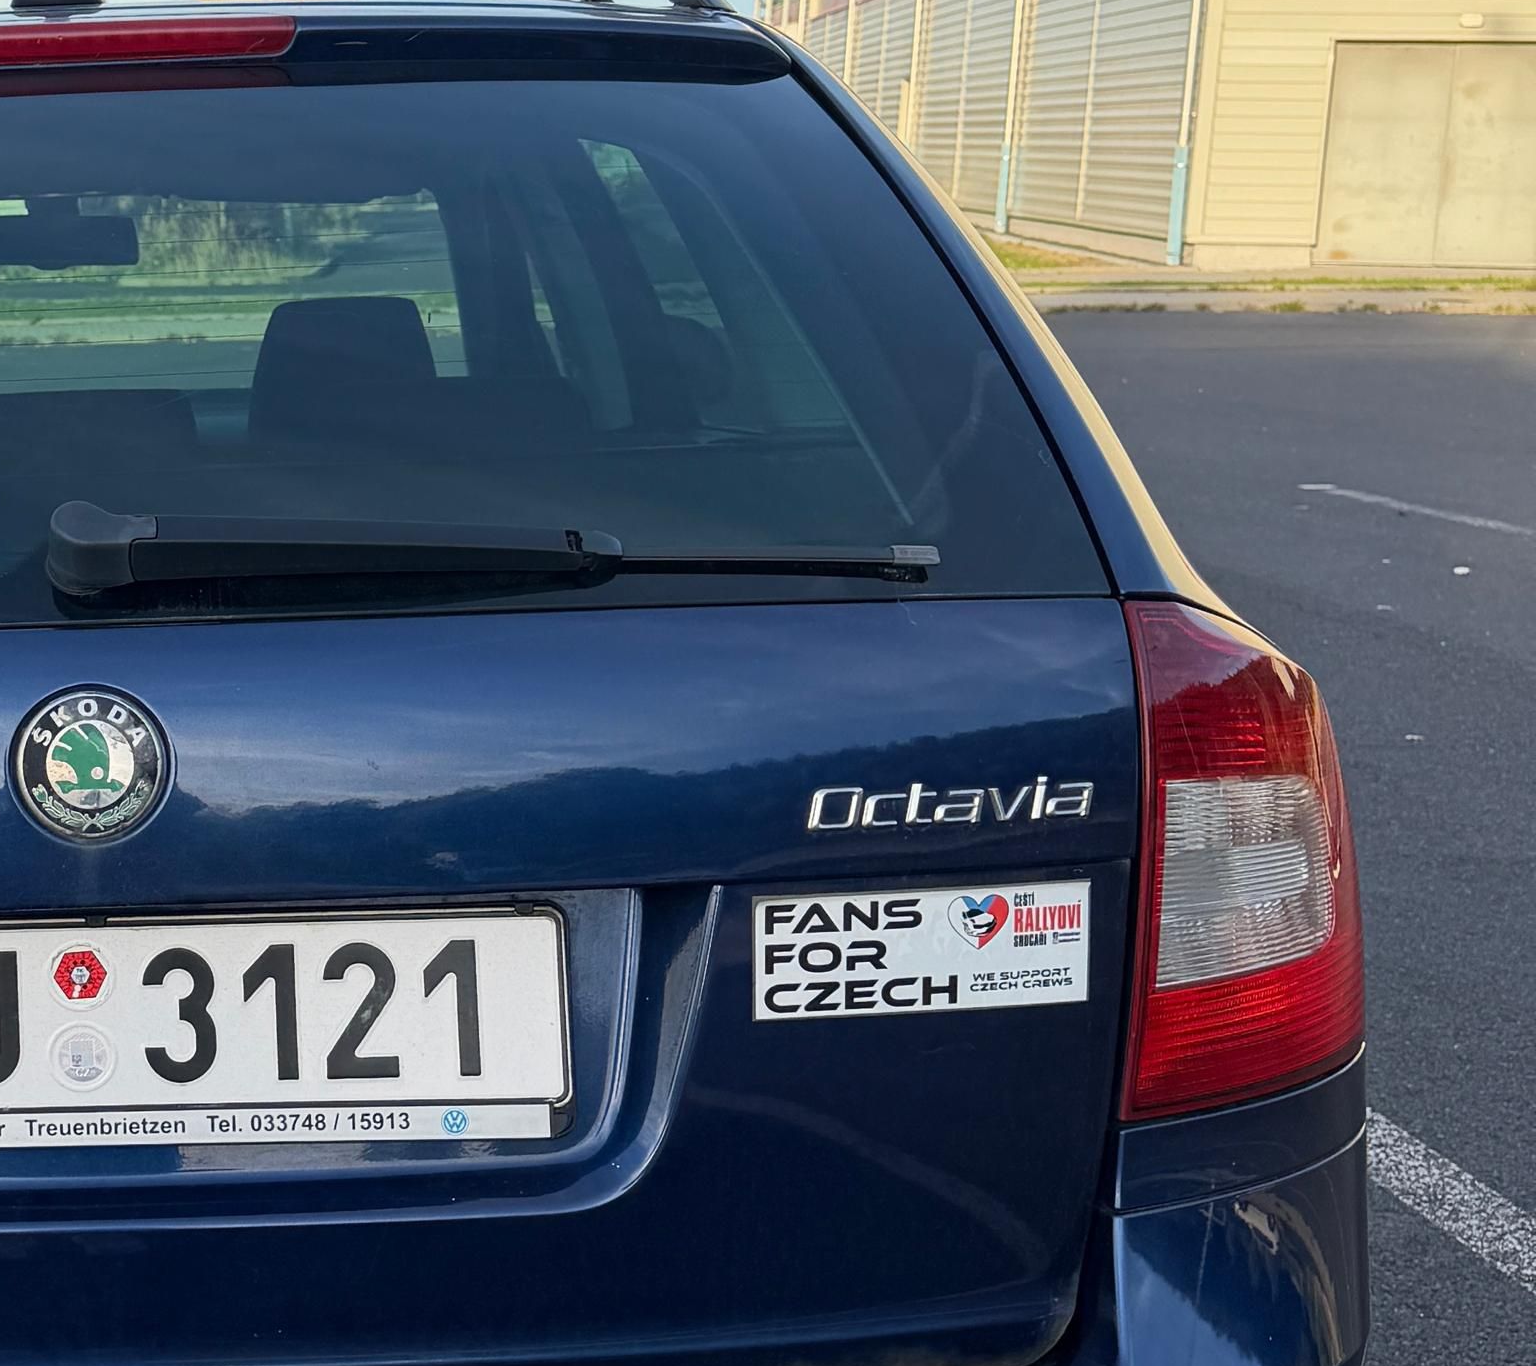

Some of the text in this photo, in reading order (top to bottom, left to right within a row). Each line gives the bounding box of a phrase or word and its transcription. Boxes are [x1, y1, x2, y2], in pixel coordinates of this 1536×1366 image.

[807, 775, 1094, 830] Octavia
[765, 898, 922, 935] FANS
[765, 940, 888, 975] FOR
[973, 967, 1070, 982] WE SUPPORT
[764, 974, 958, 1014] CZECH
[970, 977, 1073, 992] CZECH CREWS
[140, 938, 482, 1082] 3121
[24, 1117, 186, 1137] Treuenbrietzen
[206, 1114, 242, 1133] Tel.
[250, 1113, 327, 1132] 033748
[346, 1112, 411, 1131] 15913
